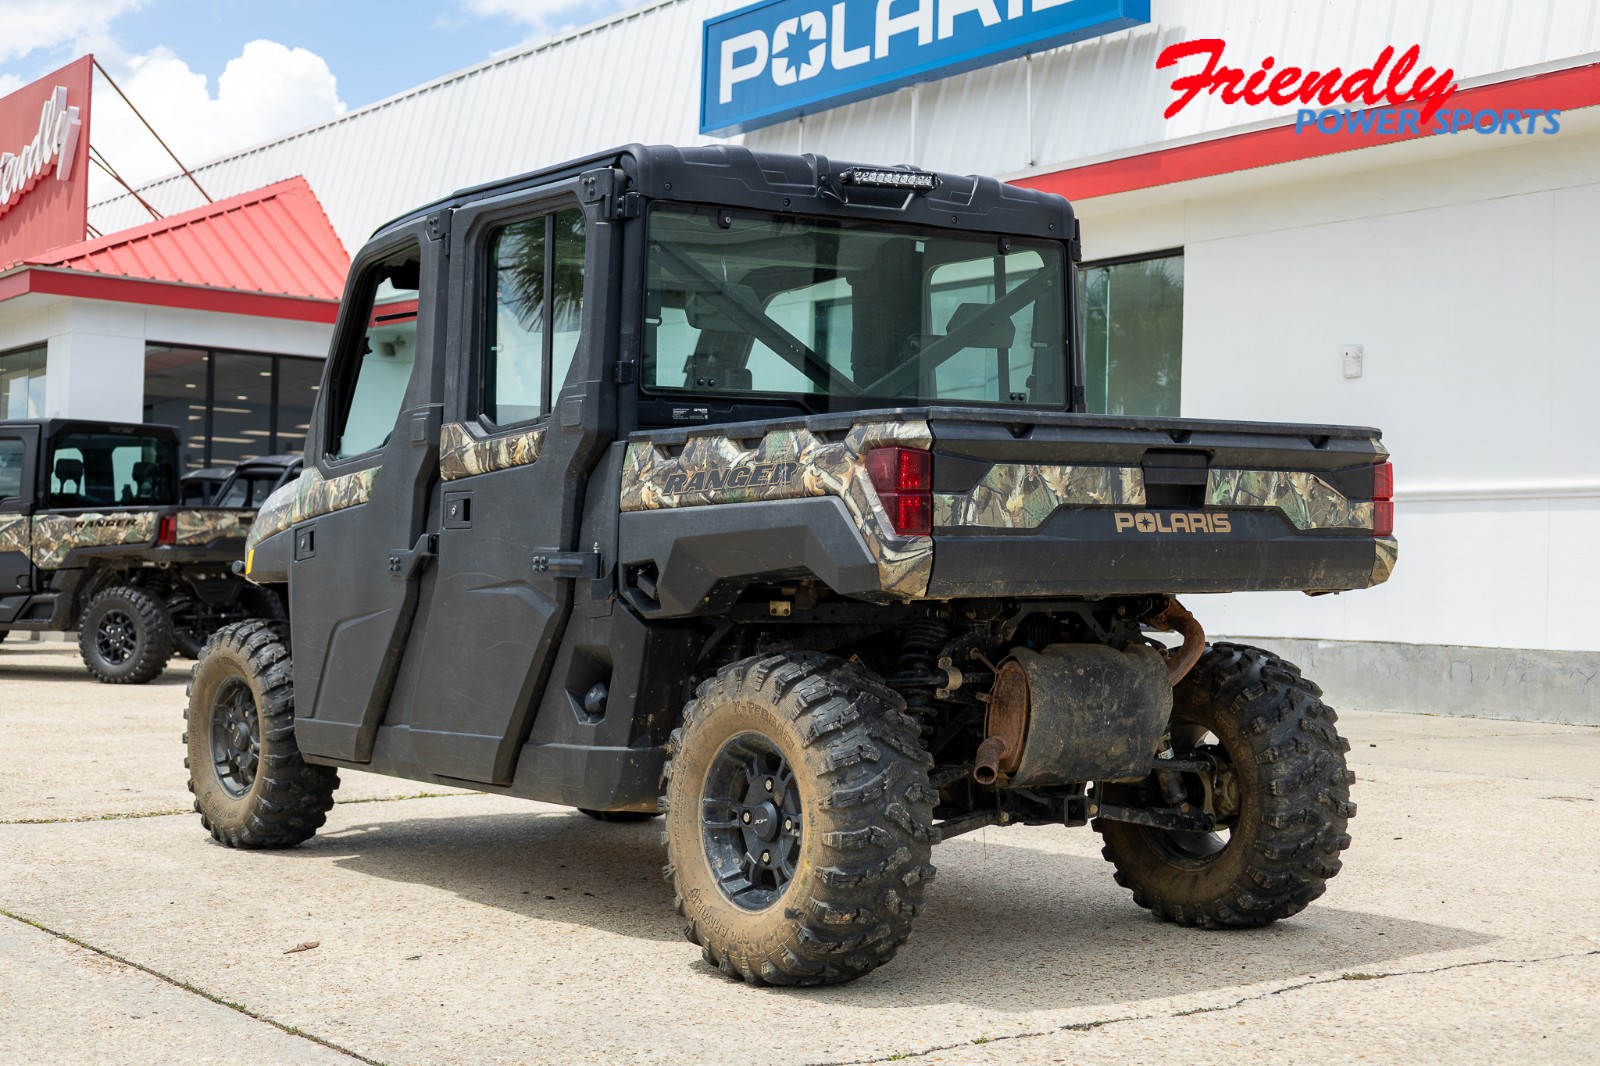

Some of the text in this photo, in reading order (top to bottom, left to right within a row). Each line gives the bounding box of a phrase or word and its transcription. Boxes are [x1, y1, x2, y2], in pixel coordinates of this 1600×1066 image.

[662, 461, 798, 496] RANGER
[74, 518, 137, 529] RANGER
[1115, 513, 1232, 534] POLARIS
